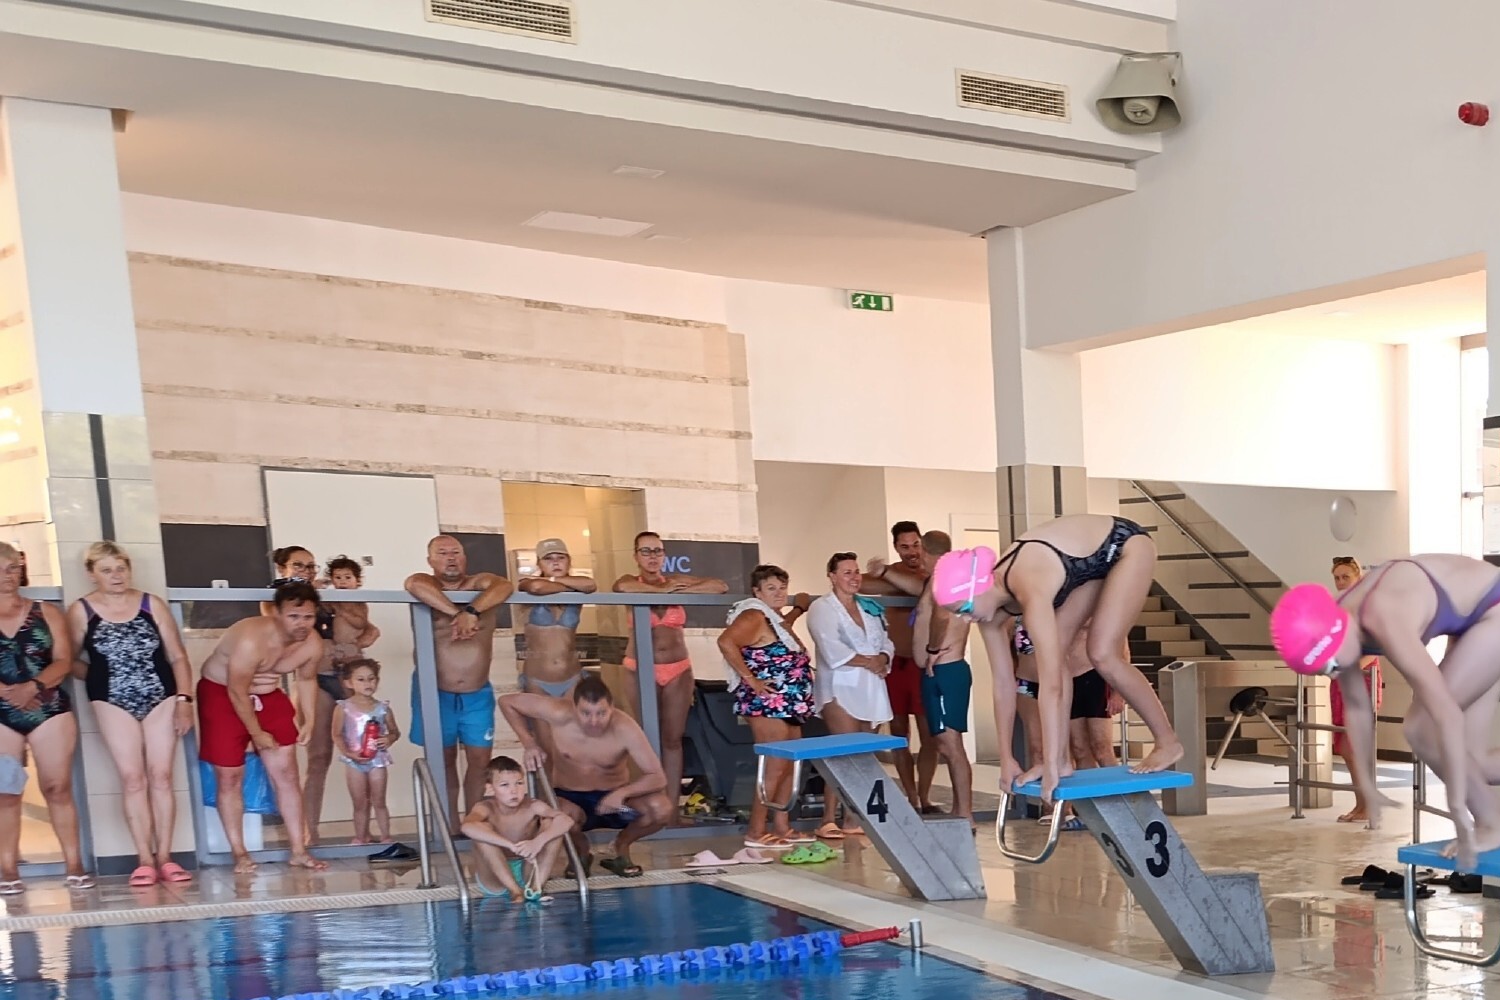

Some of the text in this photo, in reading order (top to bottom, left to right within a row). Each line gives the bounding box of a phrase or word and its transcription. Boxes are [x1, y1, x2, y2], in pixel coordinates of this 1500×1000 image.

[867, 779, 889, 823] 4
[1101, 832, 1135, 878] 3
[1145, 821, 1170, 878] 3
